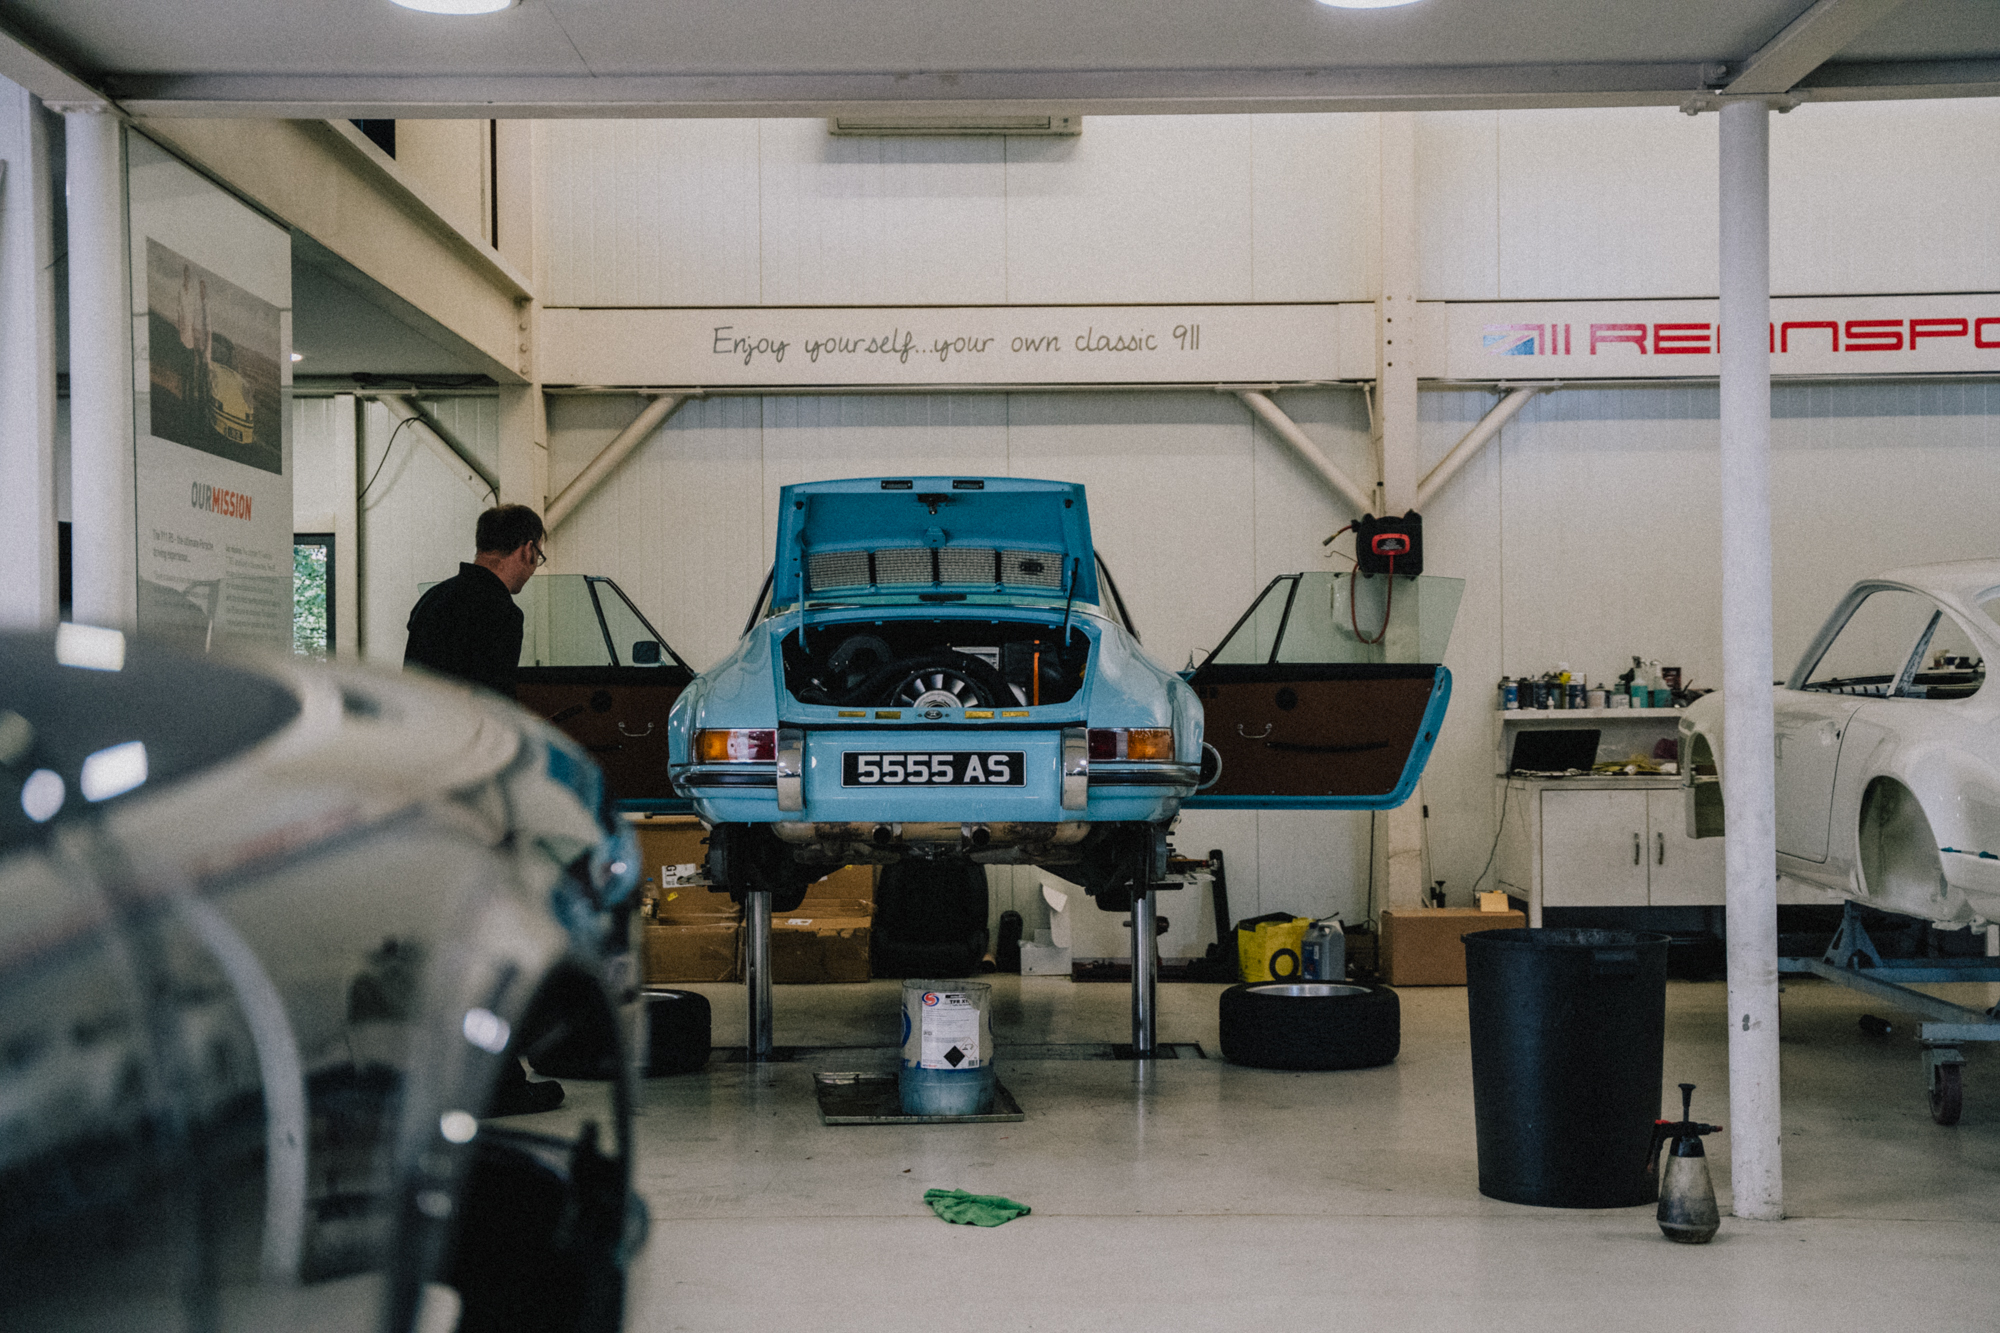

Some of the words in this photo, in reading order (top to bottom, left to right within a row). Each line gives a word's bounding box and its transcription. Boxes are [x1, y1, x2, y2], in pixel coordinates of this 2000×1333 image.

[713, 326, 790, 366] Enjoy
[1011, 336, 1061, 353] own
[1075, 326, 1158, 352] classic
[1172, 324, 1200, 351] 911
[1590, 317, 2000, 356] RENSP
[857, 754, 954, 783] 5555
[963, 754, 1010, 783] AS
